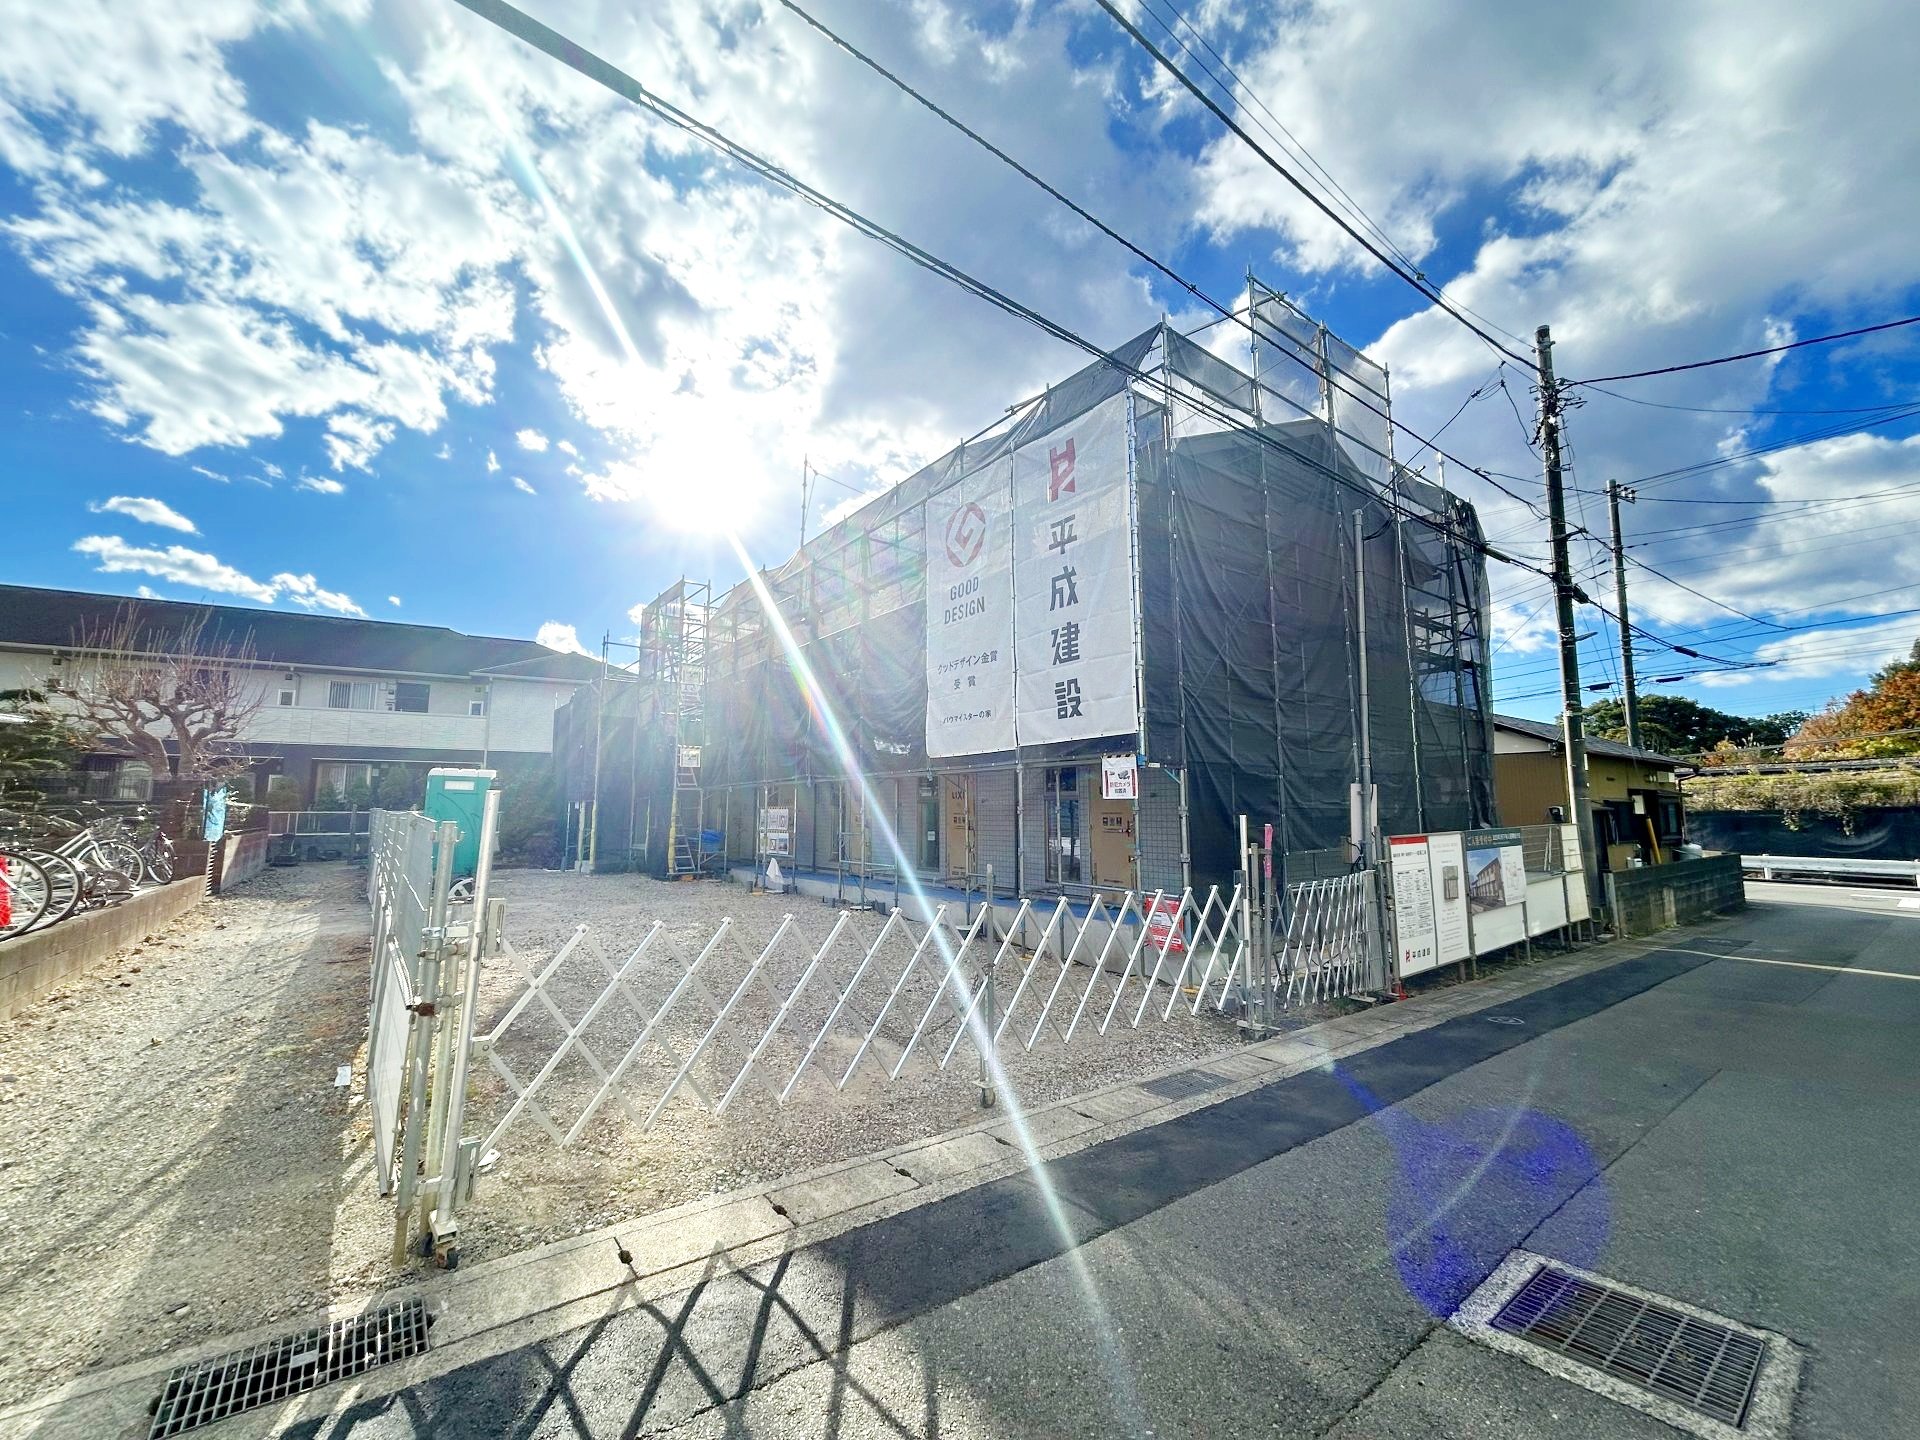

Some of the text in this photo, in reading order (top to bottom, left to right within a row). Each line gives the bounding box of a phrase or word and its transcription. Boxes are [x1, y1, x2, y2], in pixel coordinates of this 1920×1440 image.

[950, 576, 979, 601] GOOD
[944, 596, 985, 625] DESIGN
[1048, 513, 1084, 720] 平成建設
